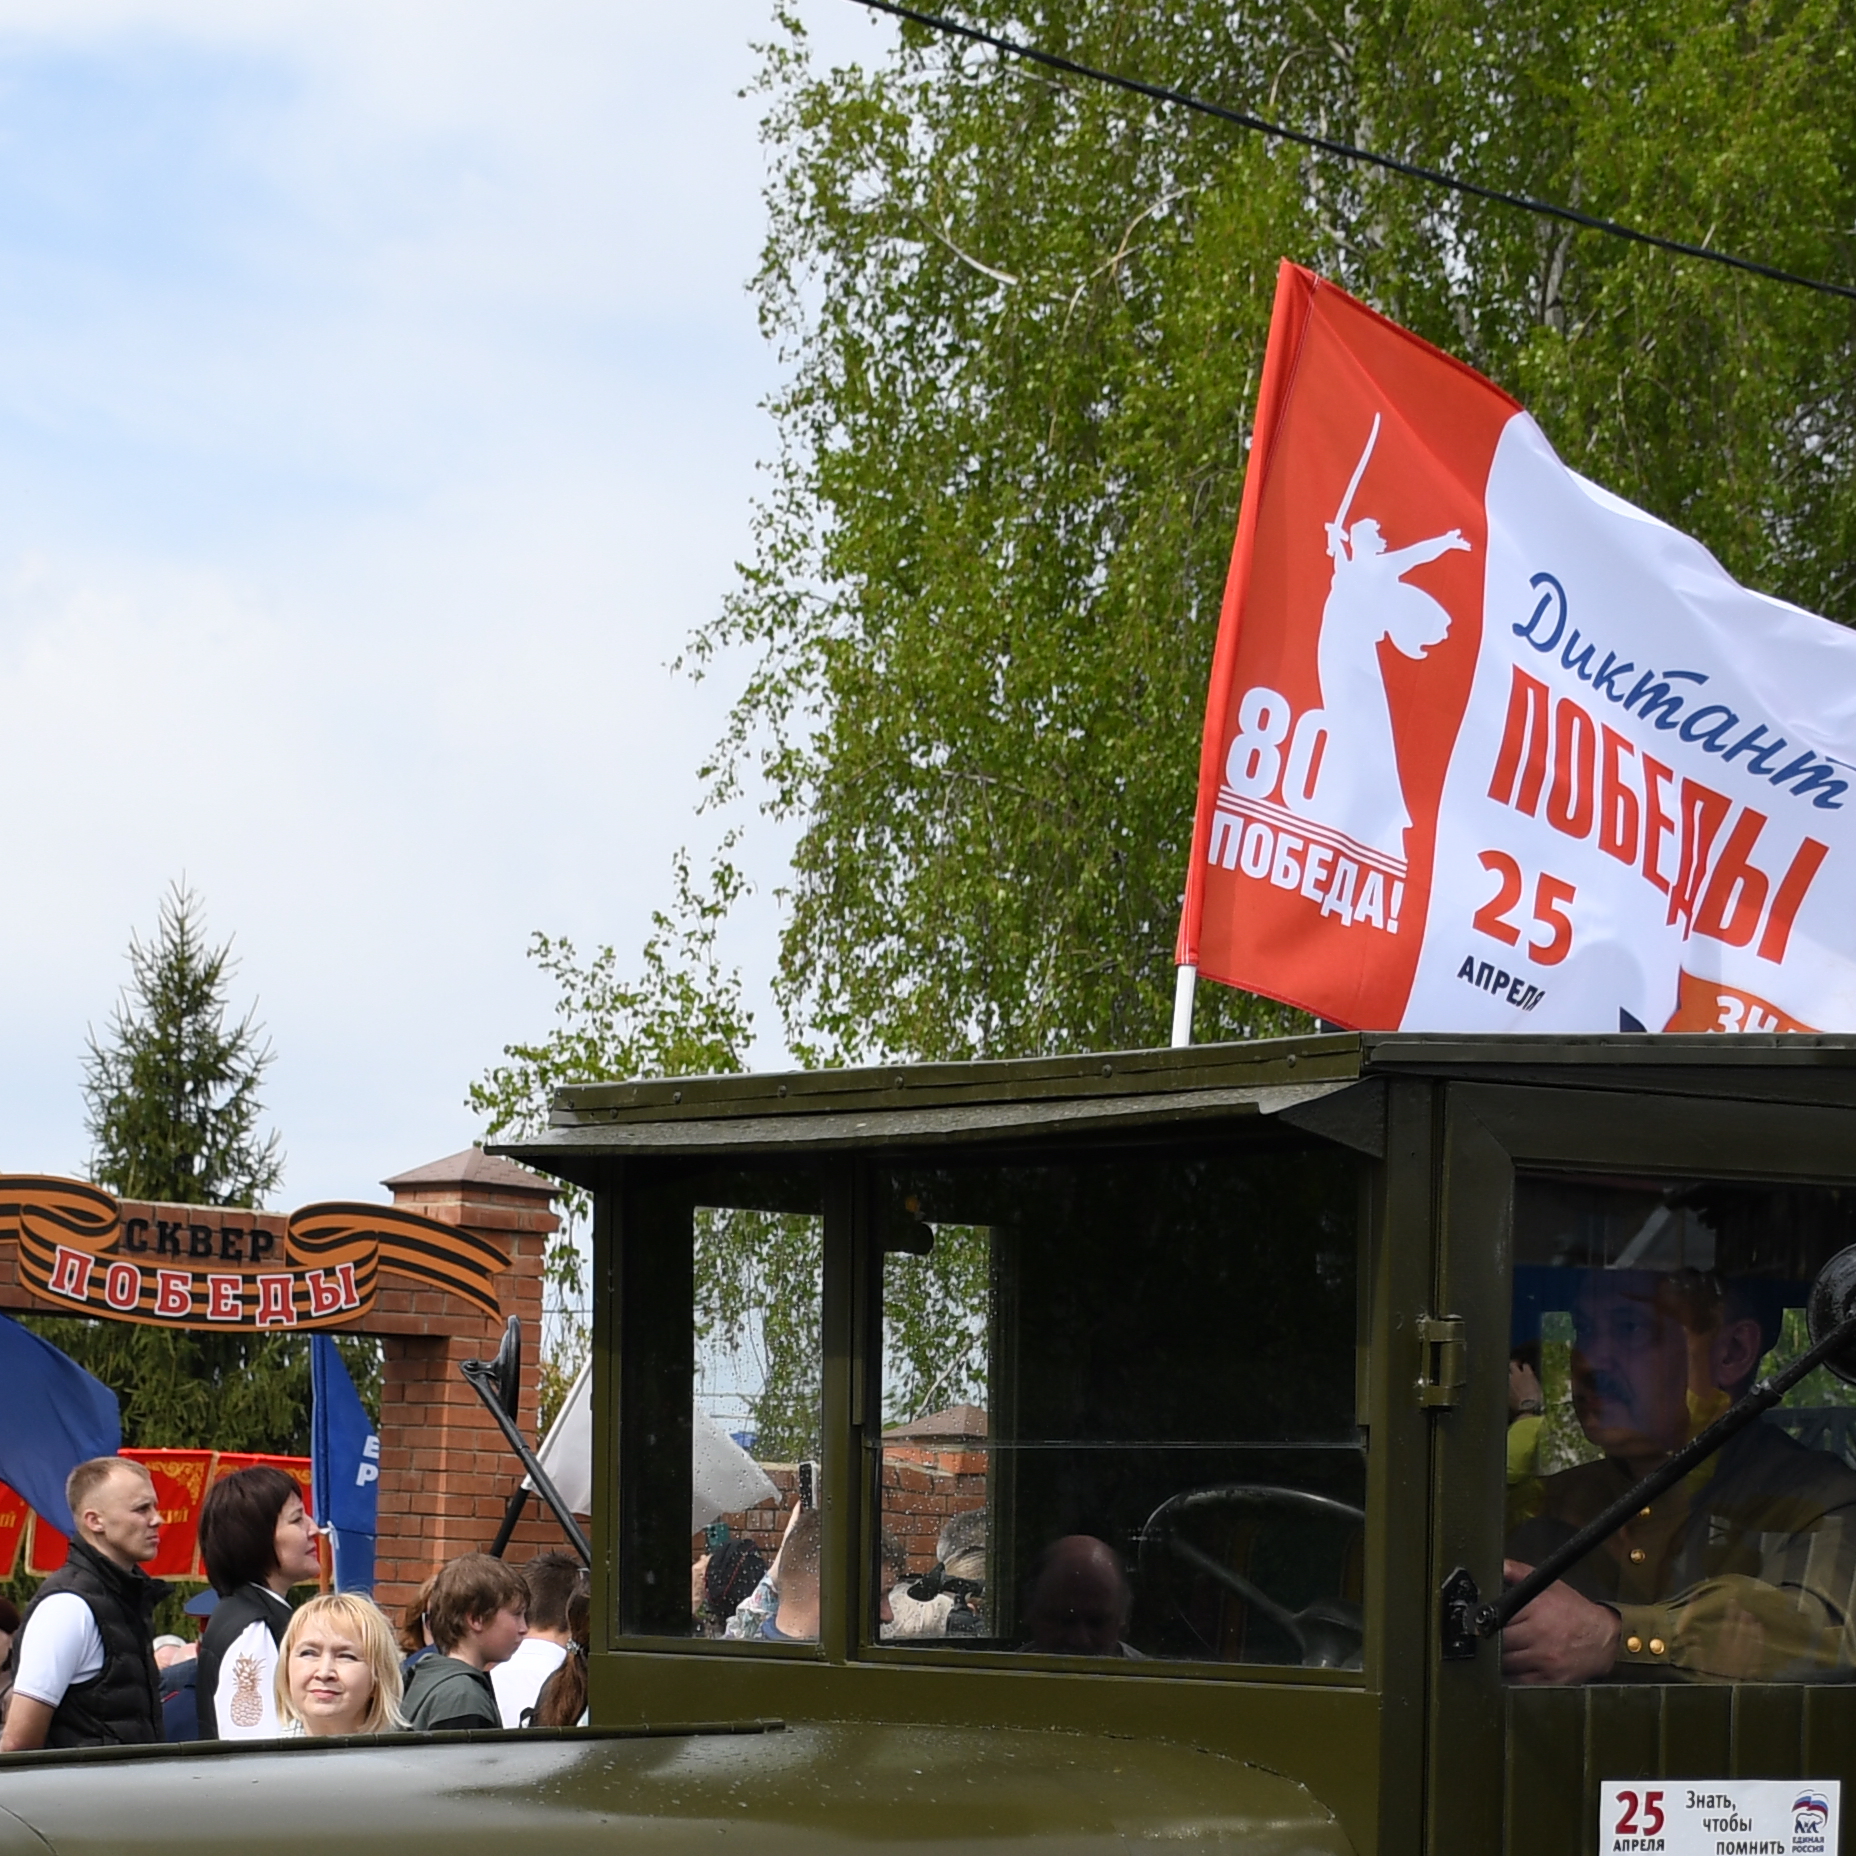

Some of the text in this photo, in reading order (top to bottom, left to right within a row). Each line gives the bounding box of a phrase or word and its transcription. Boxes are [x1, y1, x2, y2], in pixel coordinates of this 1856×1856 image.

[1225, 686, 1332, 812] 80
[1487, 663, 1830, 965] ПОБЕДЫ
[1208, 809, 1405, 934] ПОБЕДА!
[1471, 849, 1577, 966] 25
[1456, 955, 1546, 1012] АПРЕЛЯ
[125, 1217, 274, 1262] СКВЕР
[48, 1245, 360, 1327] ПОБЕДЫ
[1615, 1790, 1665, 1836] 25
[1685, 1790, 1737, 1811] Знать,
[1703, 1812, 1752, 1832] чтобы
[1613, 1838, 1665, 1852] АПРЕЛЯ
[1716, 1840, 1785, 1855] помнить
